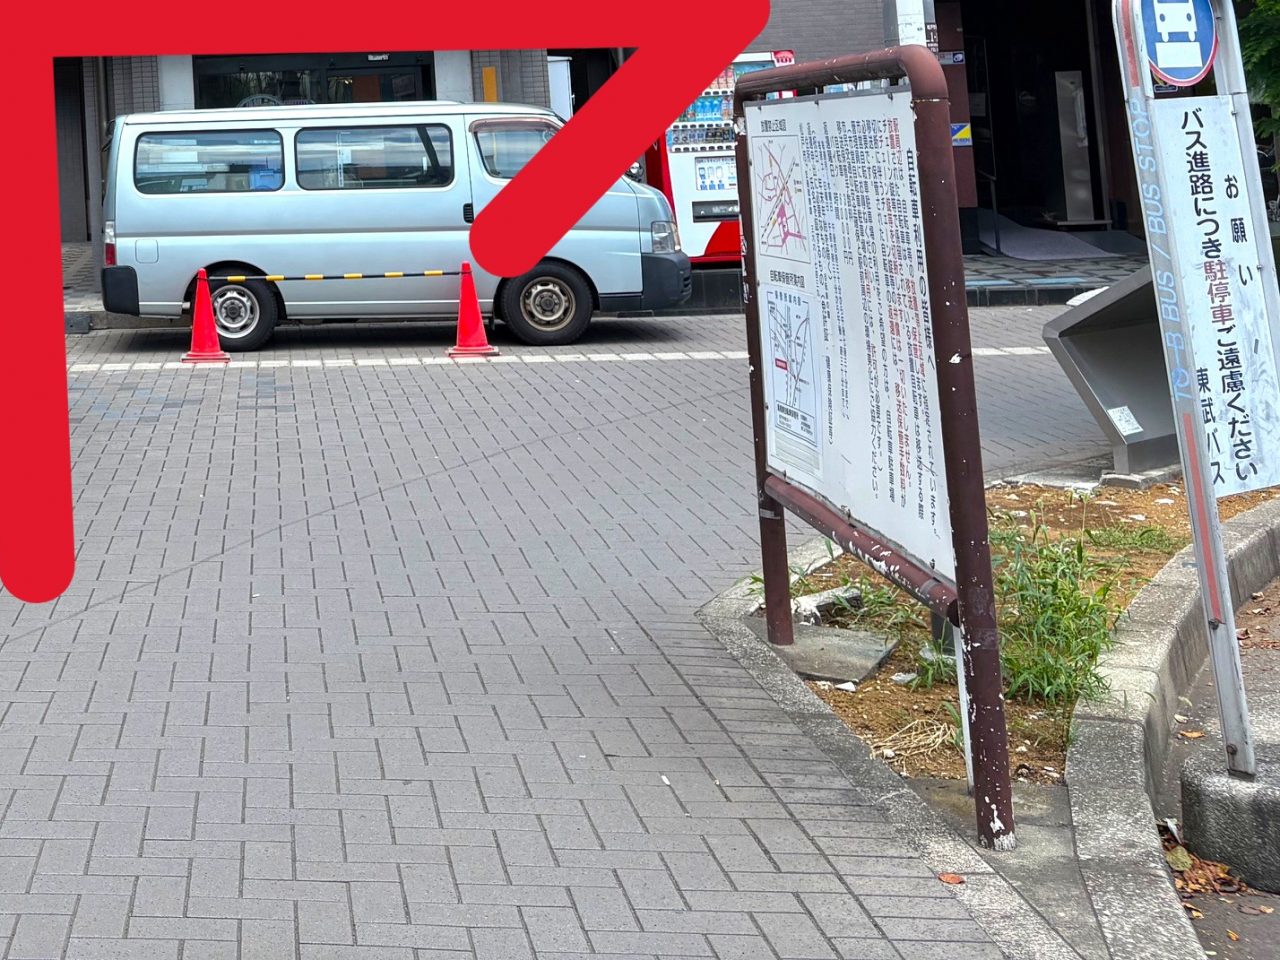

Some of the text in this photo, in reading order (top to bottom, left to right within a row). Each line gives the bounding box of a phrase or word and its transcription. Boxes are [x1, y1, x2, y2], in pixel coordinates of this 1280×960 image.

[1130, 100, 1158, 173] STOP
[1142, 184, 1167, 235] BUS
[1224, 173, 1254, 287] お願い
[1156, 271, 1181, 322] BUS
[1196, 368, 1226, 485] 東武バス
